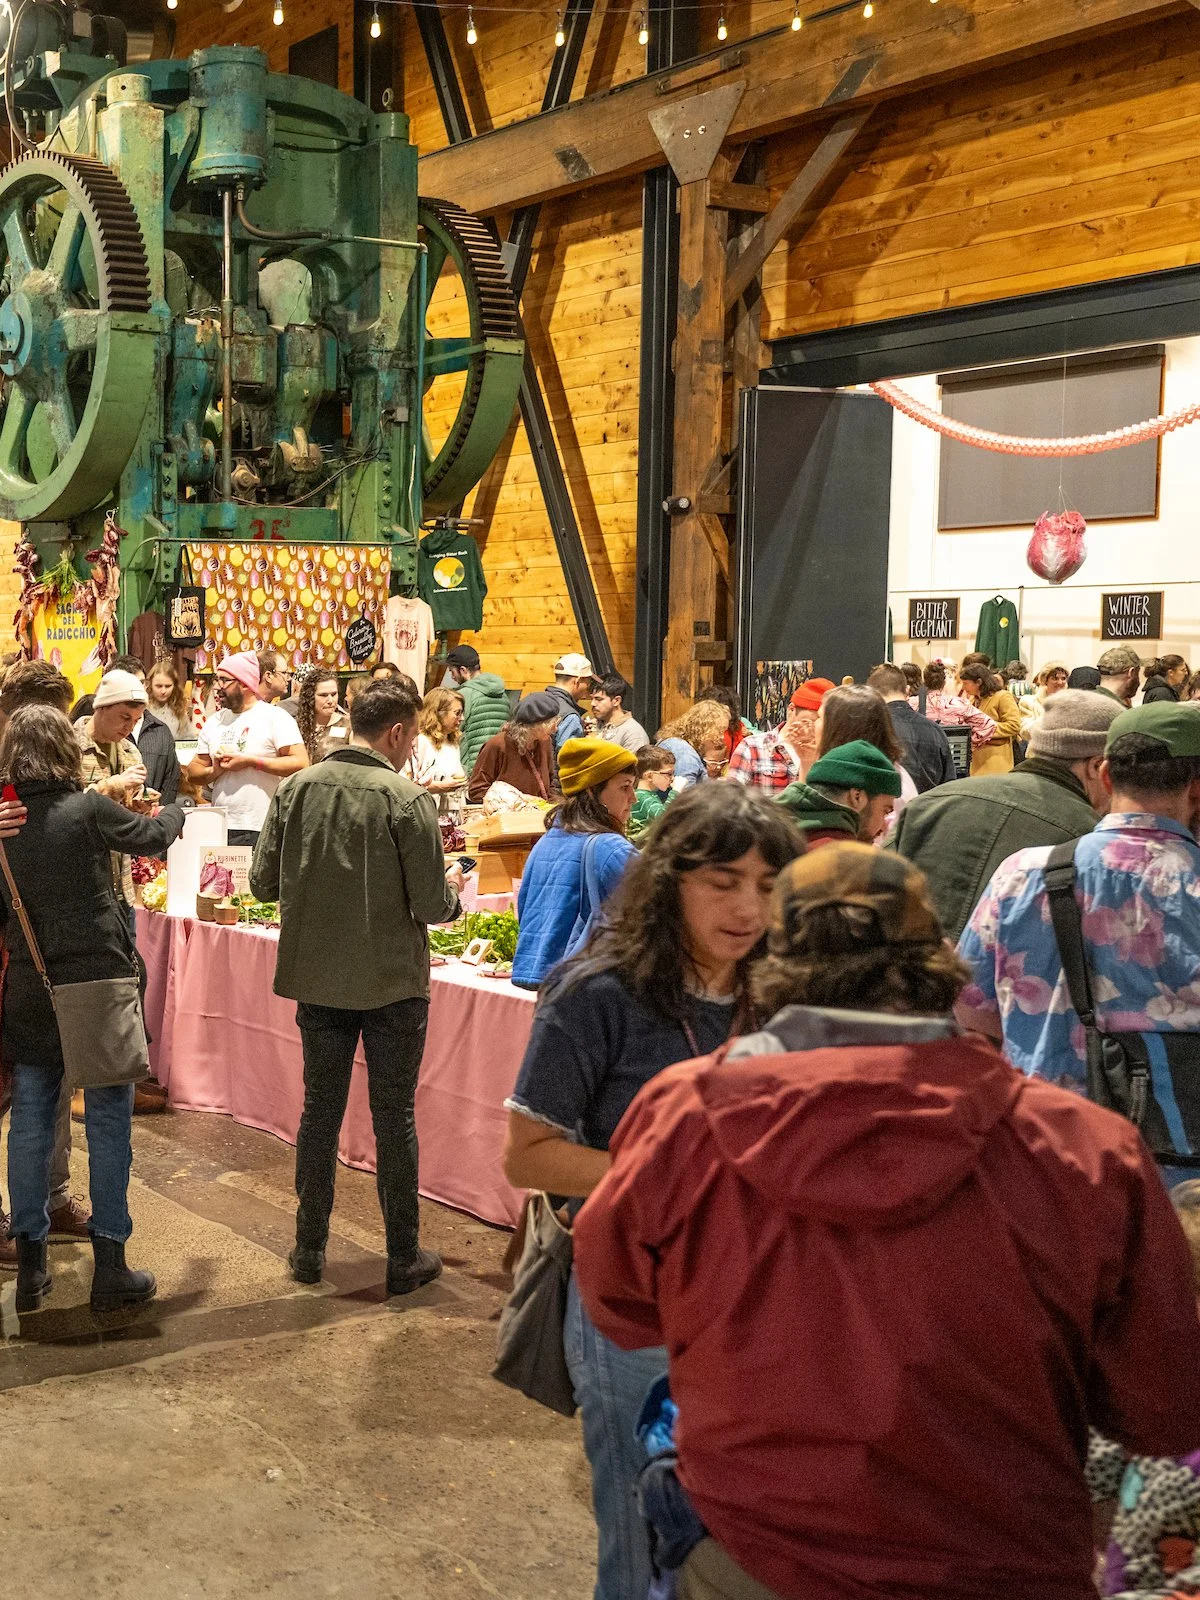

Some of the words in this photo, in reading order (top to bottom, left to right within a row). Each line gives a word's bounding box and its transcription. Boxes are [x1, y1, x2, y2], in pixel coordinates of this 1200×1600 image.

[916, 601, 948, 619] BITTER
[1109, 595, 1150, 616] WINTER
[63, 615, 75, 625] DEL
[911, 619, 954, 638] EGGPLANT
[1107, 617, 1148, 636] SQUASH
[47, 627, 96, 640] RADICCHIO
[348, 624, 372, 640] Culinary
[352, 644, 374, 656] Network
